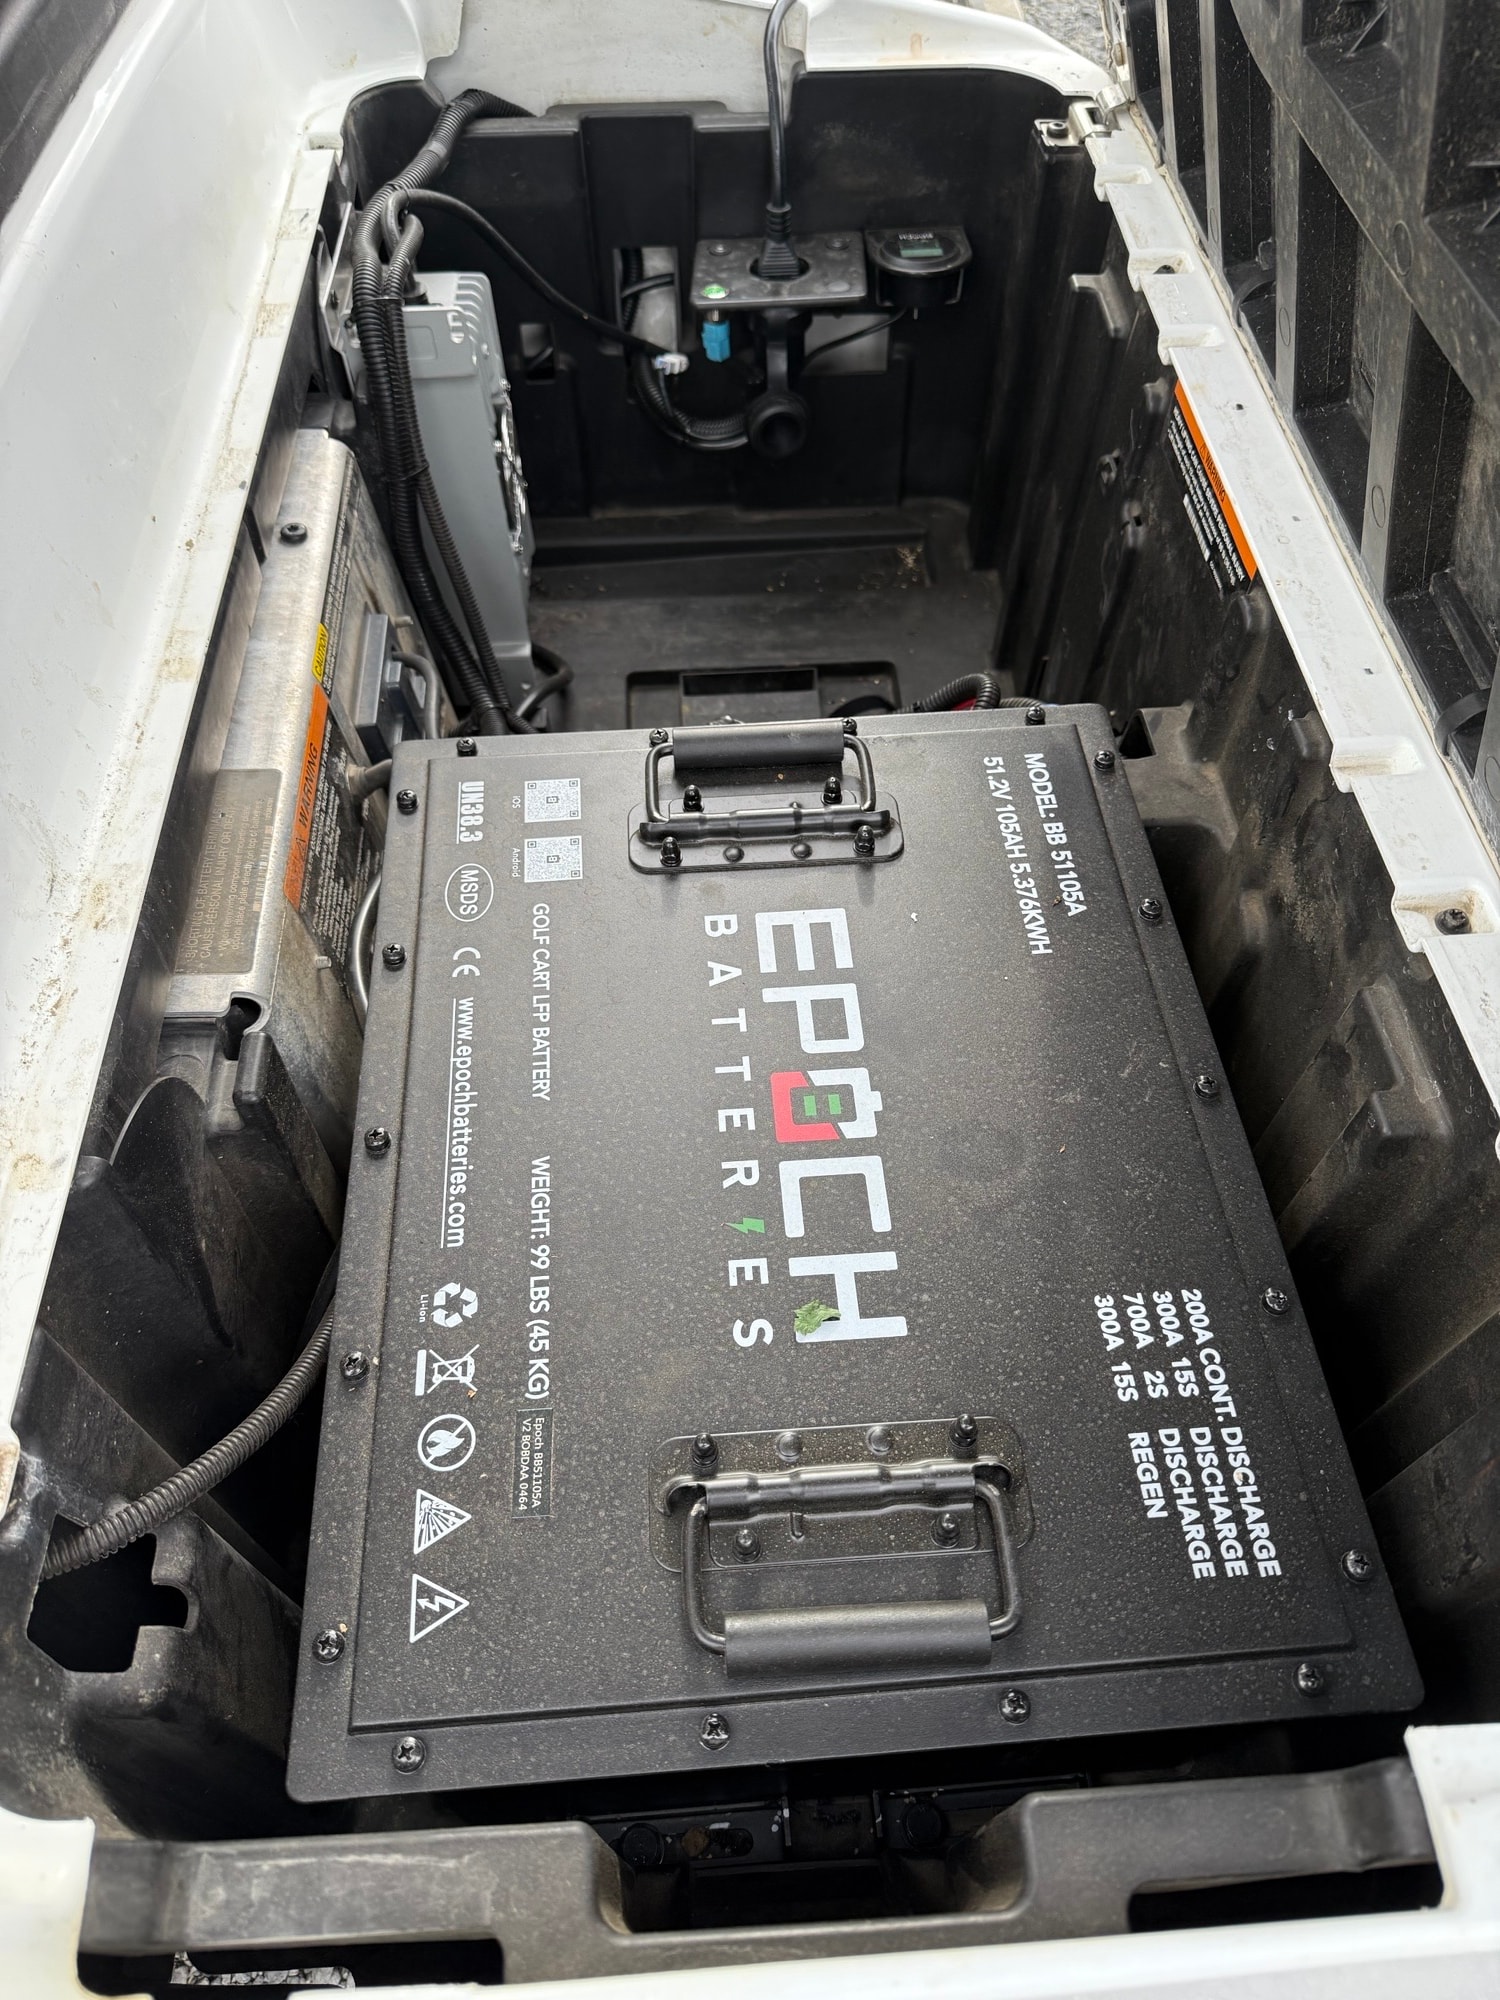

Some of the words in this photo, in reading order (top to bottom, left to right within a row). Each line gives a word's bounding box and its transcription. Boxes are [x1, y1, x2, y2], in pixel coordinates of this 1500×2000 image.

[1206, 452, 1227, 502] WARNING
[315, 628, 328, 677] CAUTION
[299, 743, 318, 828] WARNING
[984, 756, 1013, 800] 51.2V
[1024, 753, 1058, 818] MODEL:
[459, 781, 485, 842] UN38.3
[512, 795, 521, 809] iOS
[222, 832, 233, 844] OR
[995, 804, 1028, 858] 105AH
[1043, 822, 1068, 845] BB
[198, 857, 213, 894] BATTERY
[215, 845, 230, 876] INJURY
[512, 847, 521, 878] Android
[1051, 850, 1088, 917] 51105A
[204, 878, 224, 925] PERSONAL
[459, 869, 479, 915] MSDS
[1010, 863, 1053, 955] 5.376KWH
[201, 927, 215, 958] CAUSE
[532, 903, 550, 945] GOLF
[532, 948, 550, 990] CART
[532, 995, 550, 1022] LFP
[532, 1026, 551, 1101] BATTERY
[447, 996, 478, 1248] www.epochbatteries.com
[755, 908, 908, 1343] EPOCH
[530, 1155, 551, 1240] WEIGHT:
[530, 1244, 549, 1269] 99
[529, 1276, 550, 1314] LBS
[526, 1319, 550, 1352] (45
[524, 1358, 550, 1400] KG)
[521, 1418, 532, 1433] V2
[1094, 1294, 1124, 1351] 300A
[1111, 1361, 1139, 1402] 15S
[1128, 1431, 1168, 1519] REGEN
[533, 1417, 545, 1450] Epoch
[1122, 1292, 1154, 1349] 700A
[1143, 1370, 1169, 1399] 2S
[1158, 1428, 1217, 1579] DISCHARGE
[1152, 1290, 1184, 1347] 300A
[1171, 1357, 1200, 1398] 15S
[1189, 1426, 1249, 1578] DISCHARGE
[1181, 1288, 1214, 1345] 200A
[1199, 1348, 1237, 1422] CONT.
[1221, 1426, 1282, 1578] DISCHARGE
[518, 1485, 528, 1511] 0464
[531, 1452, 544, 1508] BB51105A
